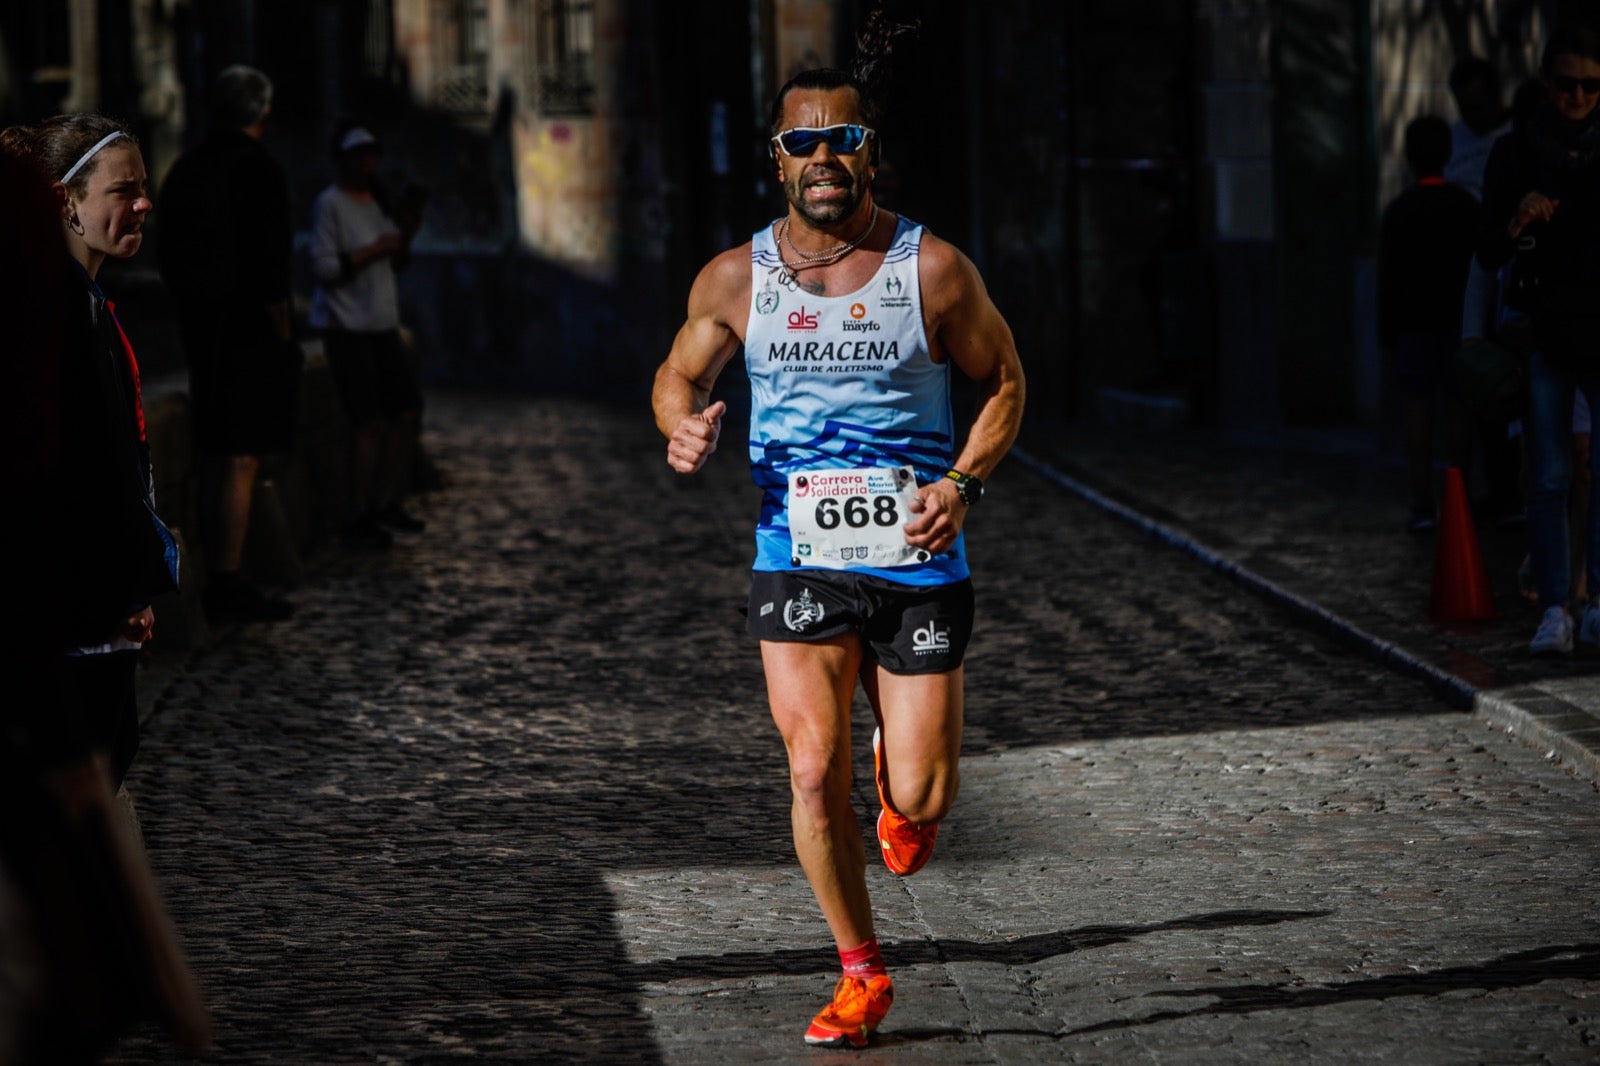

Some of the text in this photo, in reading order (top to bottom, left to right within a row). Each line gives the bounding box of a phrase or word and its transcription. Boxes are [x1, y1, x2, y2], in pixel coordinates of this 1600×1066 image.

[843, 320, 880, 333] mayfo
[768, 341, 899, 361] MARACENA
[783, 364, 884, 373] CLUB DE ATLETISMO
[811, 475, 863, 486] Carrera
[811, 485, 867, 498] Solidaria
[815, 495, 899, 530] 668
